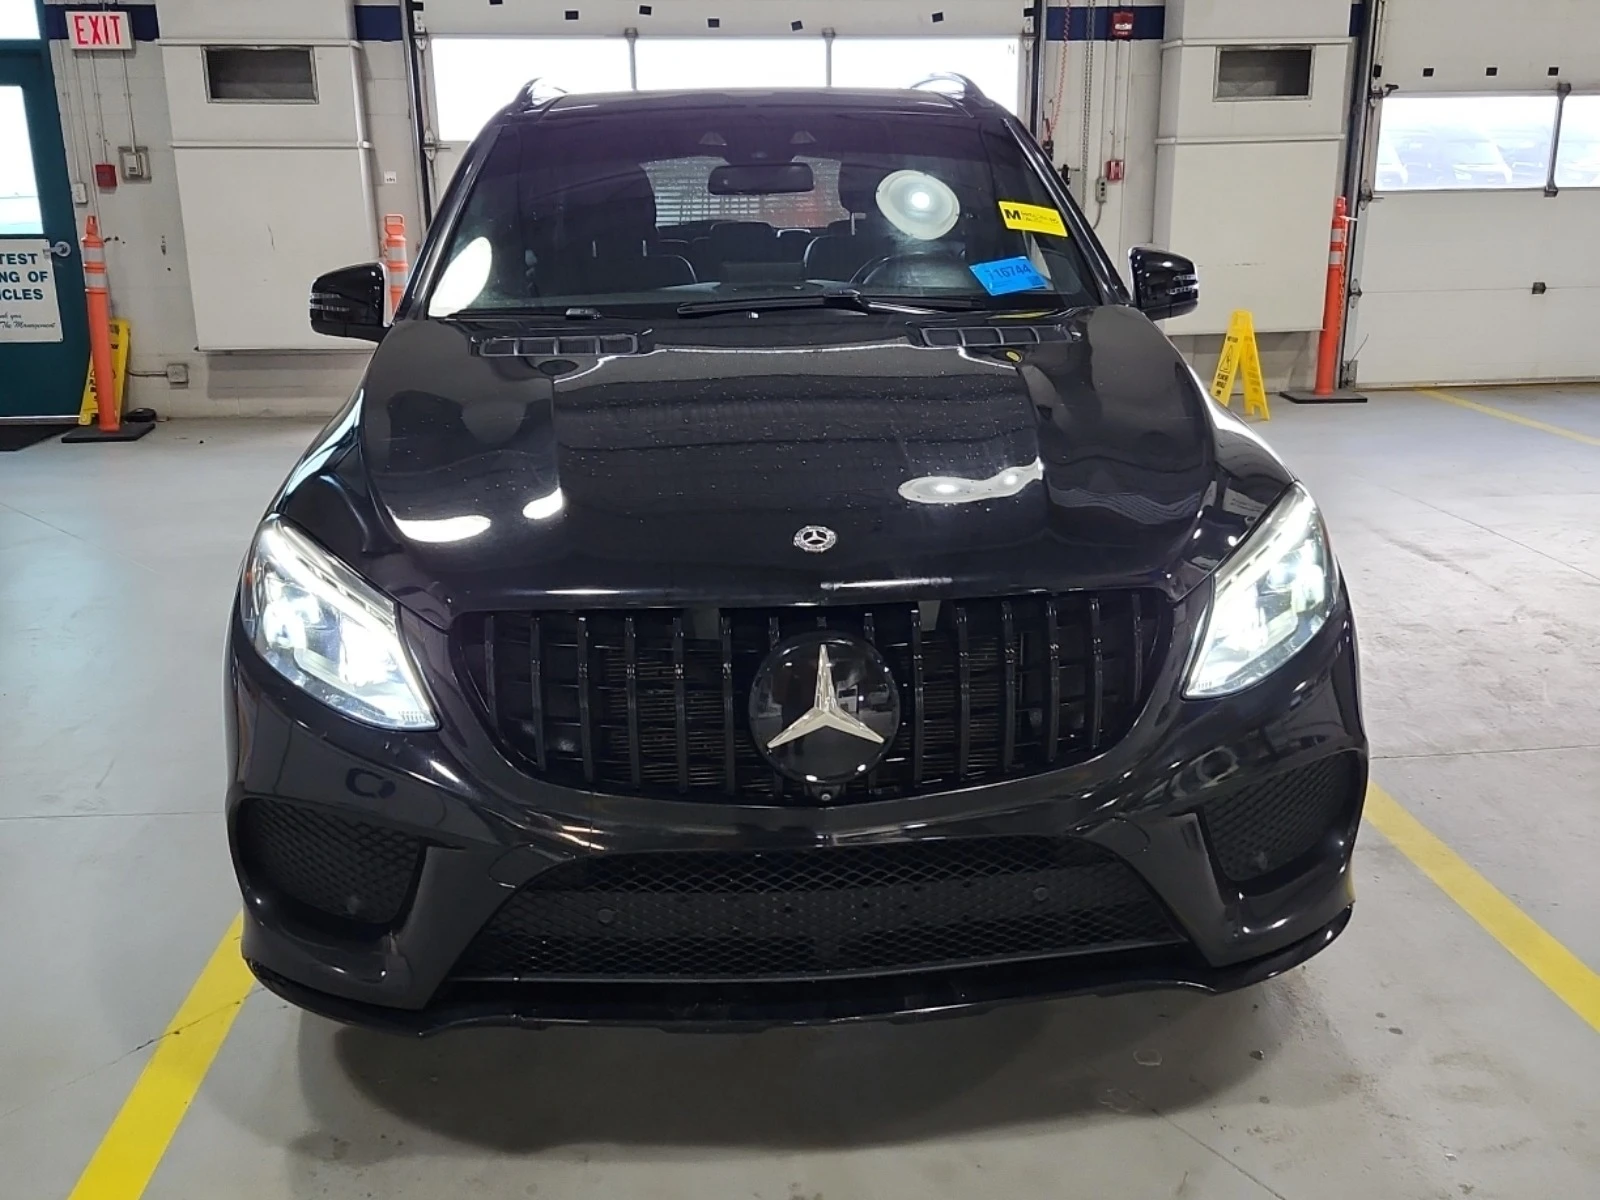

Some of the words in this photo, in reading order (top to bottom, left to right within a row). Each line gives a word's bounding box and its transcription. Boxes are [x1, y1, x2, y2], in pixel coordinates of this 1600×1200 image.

[73, 15, 120, 45] EXIT
[1003, 208, 1022, 221] M
[0, 253, 38, 265] TEST
[27, 271, 48, 283] OF
